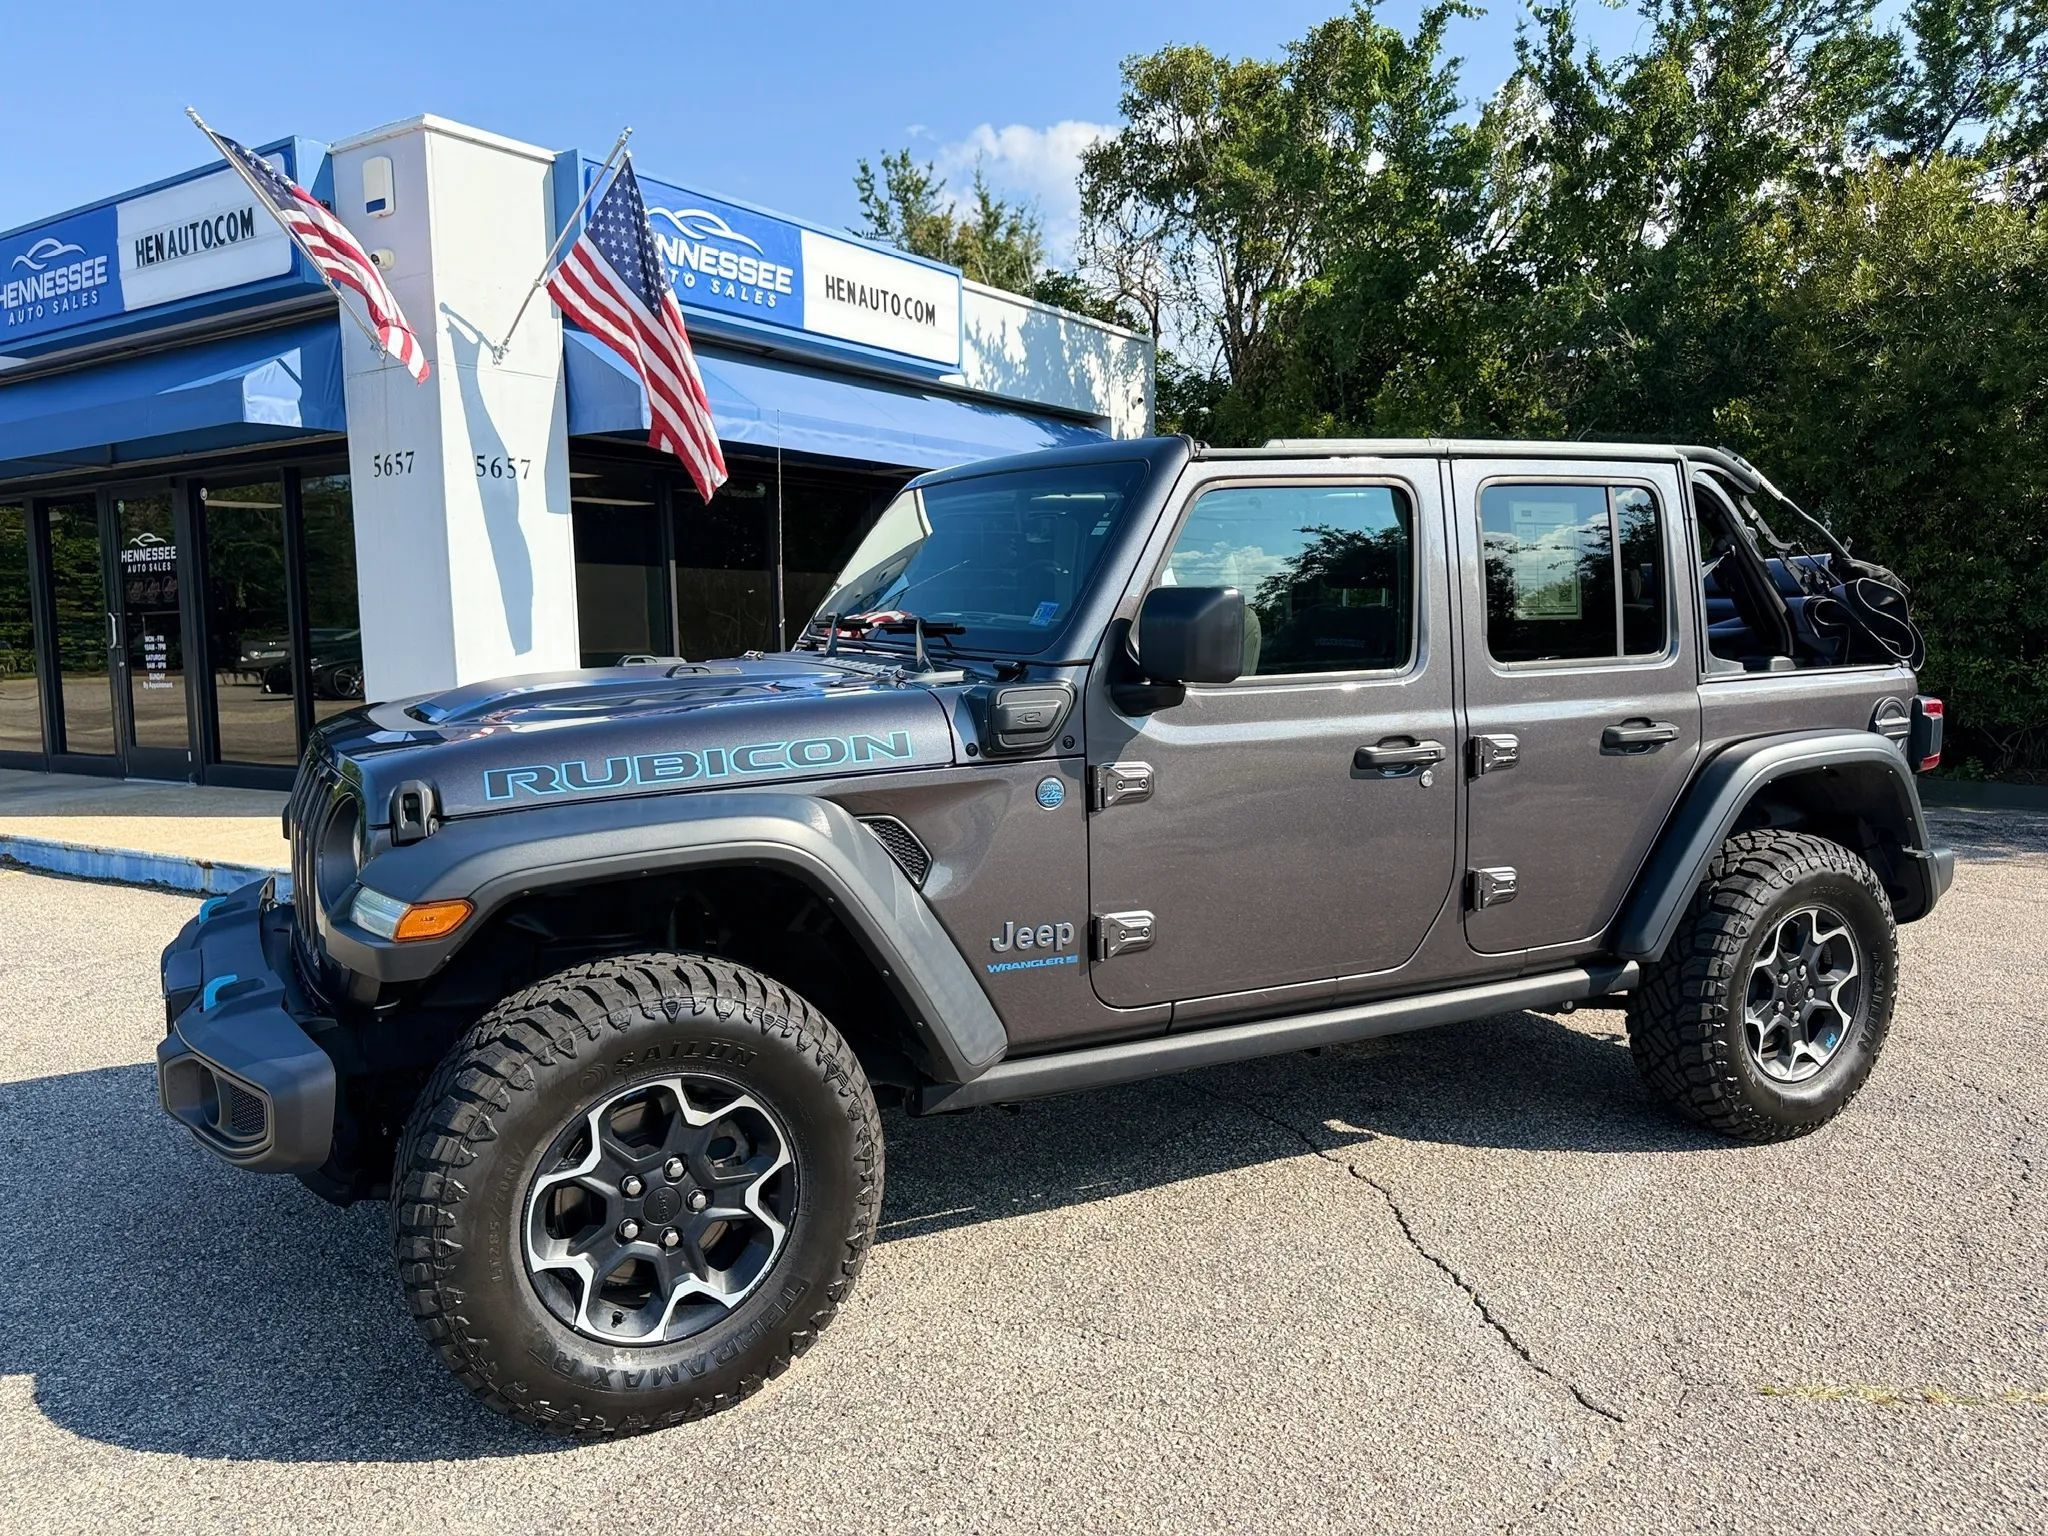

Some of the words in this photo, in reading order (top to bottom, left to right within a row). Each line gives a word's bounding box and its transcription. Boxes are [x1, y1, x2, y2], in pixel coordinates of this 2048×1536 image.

[134, 206, 255, 268] HENAUTO.COM
[654, 231, 795, 296] NNESSEE
[668, 267, 697, 289] TO
[710, 278, 778, 308] SALES
[825, 274, 937, 327] HENAUTOCOM
[8, 305, 44, 326] AUTO
[53, 290, 98, 314] SALES
[373, 450, 415, 478] 5657
[475, 453, 532, 481] 5657
[121, 545, 177, 563] HENNESSEE
[127, 563, 147, 574] AUTO
[149, 561, 171, 573] SALES
[484, 730, 913, 801] RUBICON
[990, 921, 1076, 953] Jeep
[986, 956, 1065, 974] WRANGLER
[614, 1040, 758, 1076] SAILUN
[592, 1276, 810, 1390] TERRAMAX
